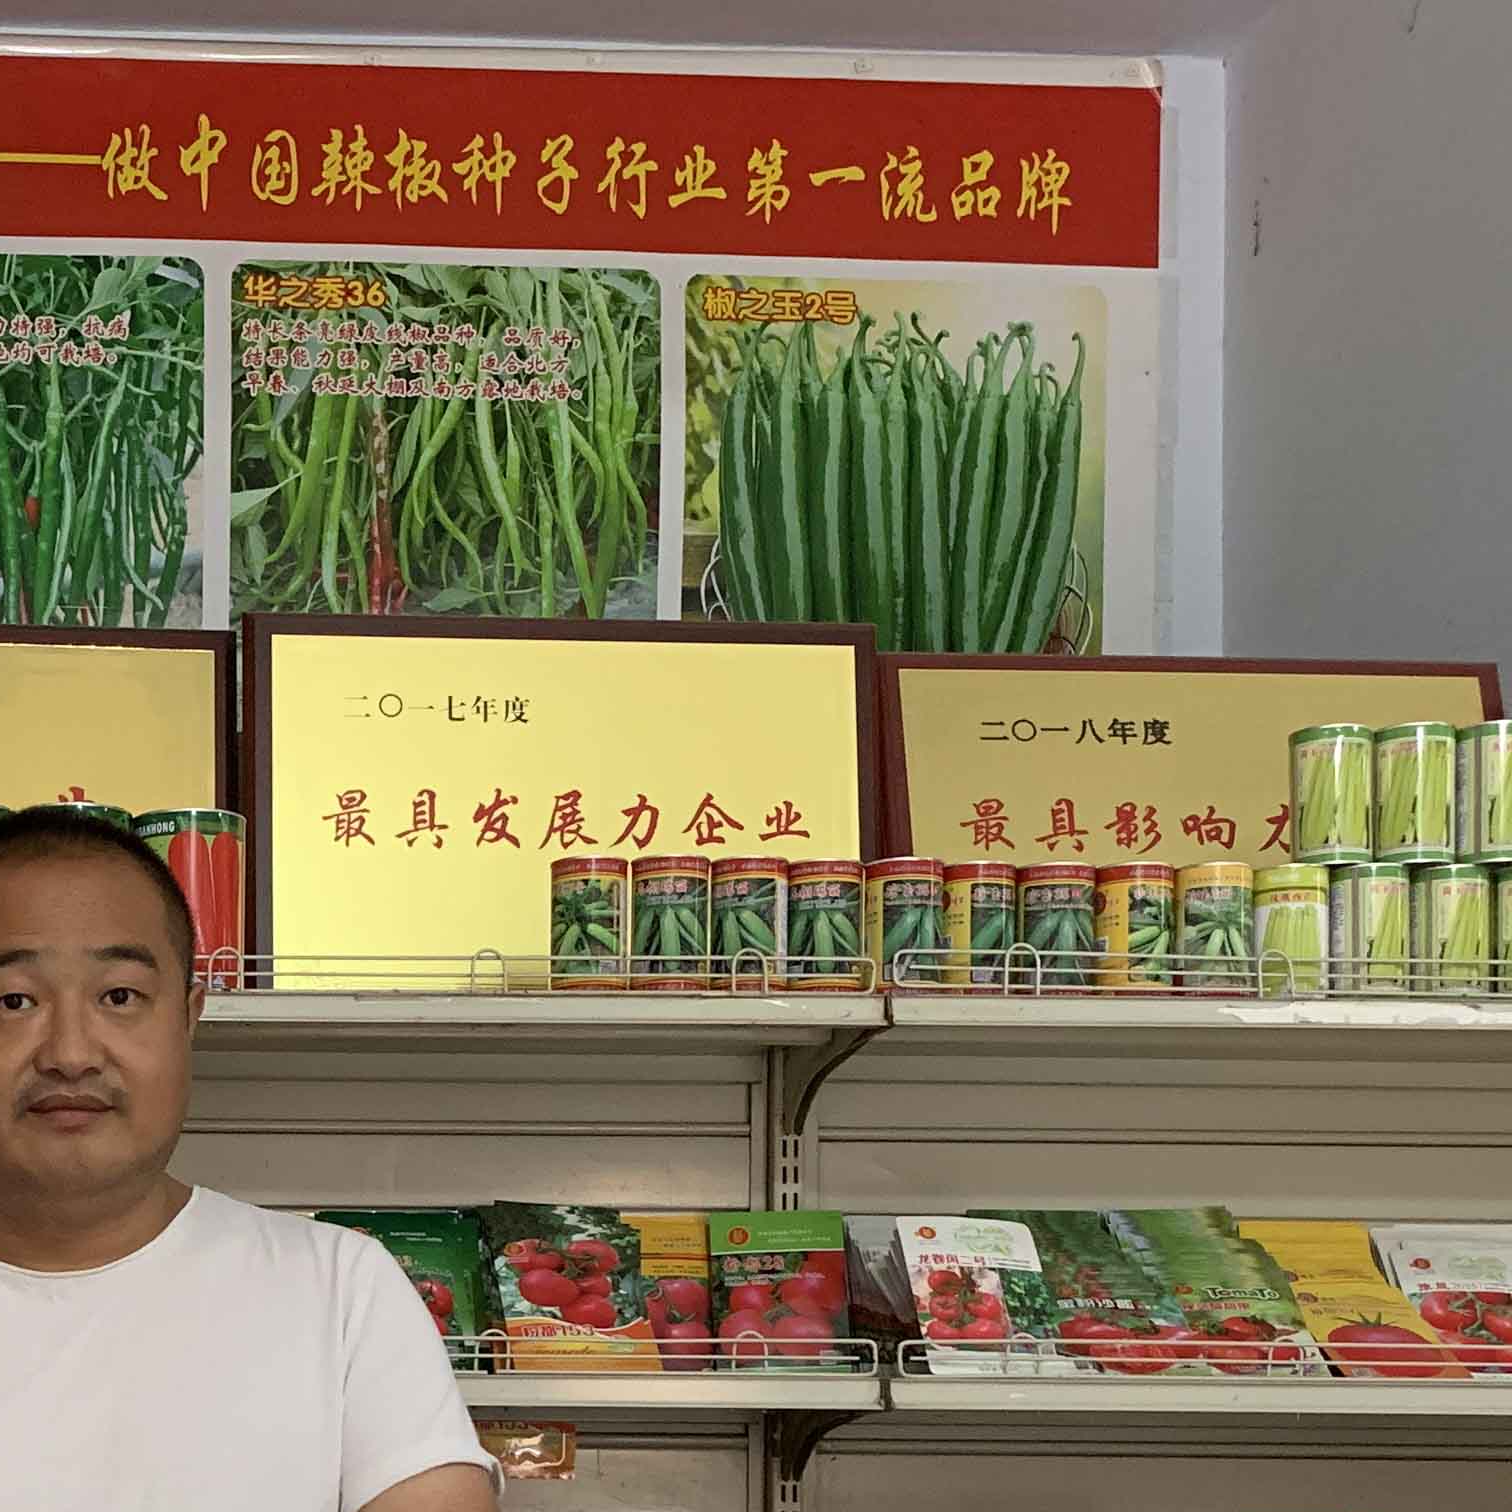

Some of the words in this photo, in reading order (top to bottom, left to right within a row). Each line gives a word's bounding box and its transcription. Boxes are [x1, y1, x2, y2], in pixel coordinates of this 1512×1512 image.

[242, 273, 386, 310] 华之秀36
[703, 286, 858, 325] 椒之玉2号
[322, 787, 811, 851] 最具发展力企业
